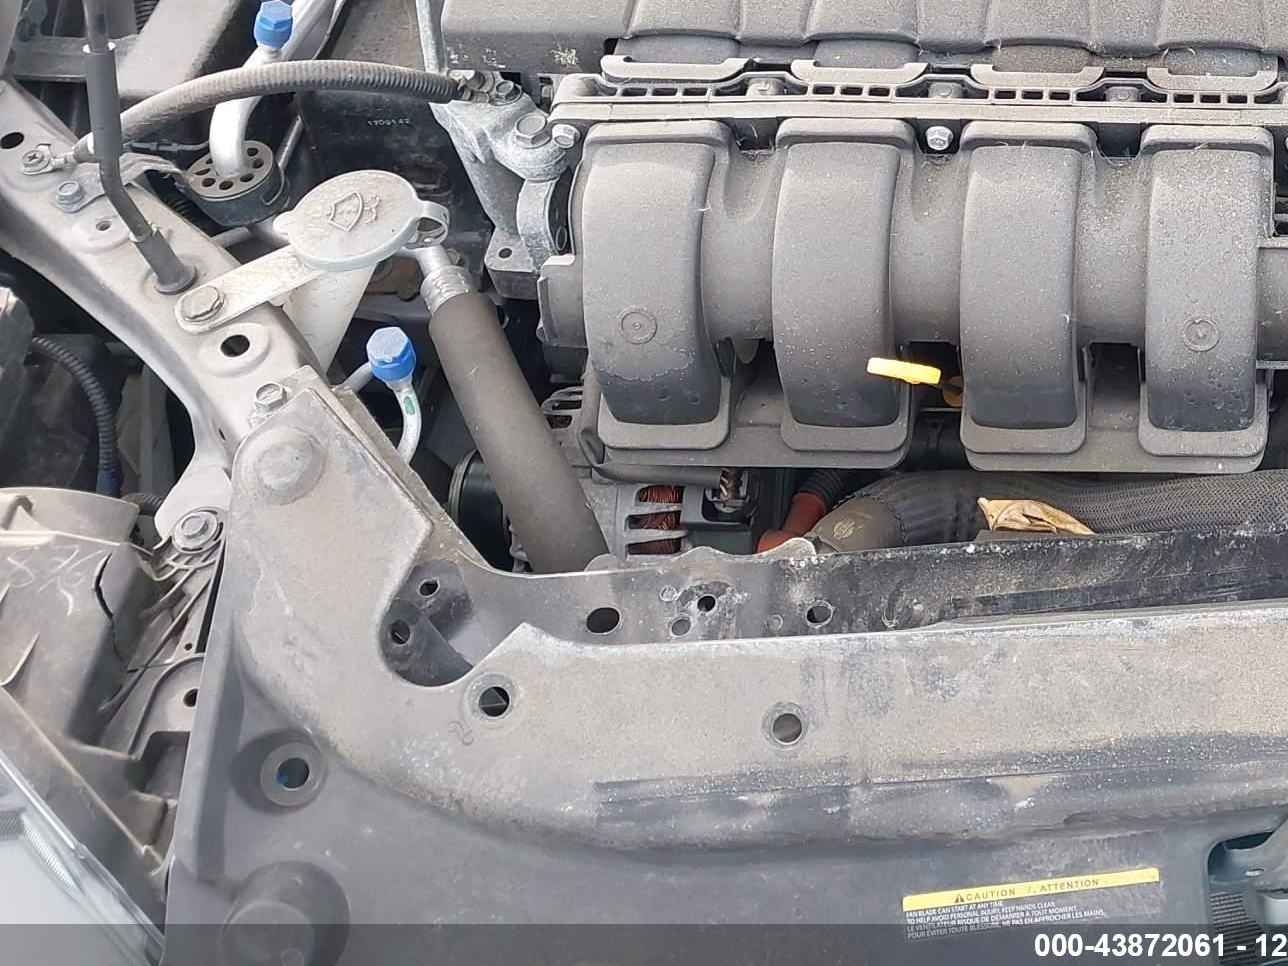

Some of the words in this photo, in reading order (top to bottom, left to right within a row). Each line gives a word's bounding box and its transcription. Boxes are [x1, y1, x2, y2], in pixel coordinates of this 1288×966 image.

[966, 888, 1016, 901] CAUTION
[1040, 879, 1099, 892] ATTENTION
[931, 914, 949, 922] AVOID
[950, 910, 980, 919] PERSONAL
[1017, 902, 1036, 910] HANDS
[908, 930, 926, 939] POUR
[949, 924, 968, 933] TOUTE
[1012, 917, 1024, 925] PAS
[1025, 916, 1033, 924] EN
